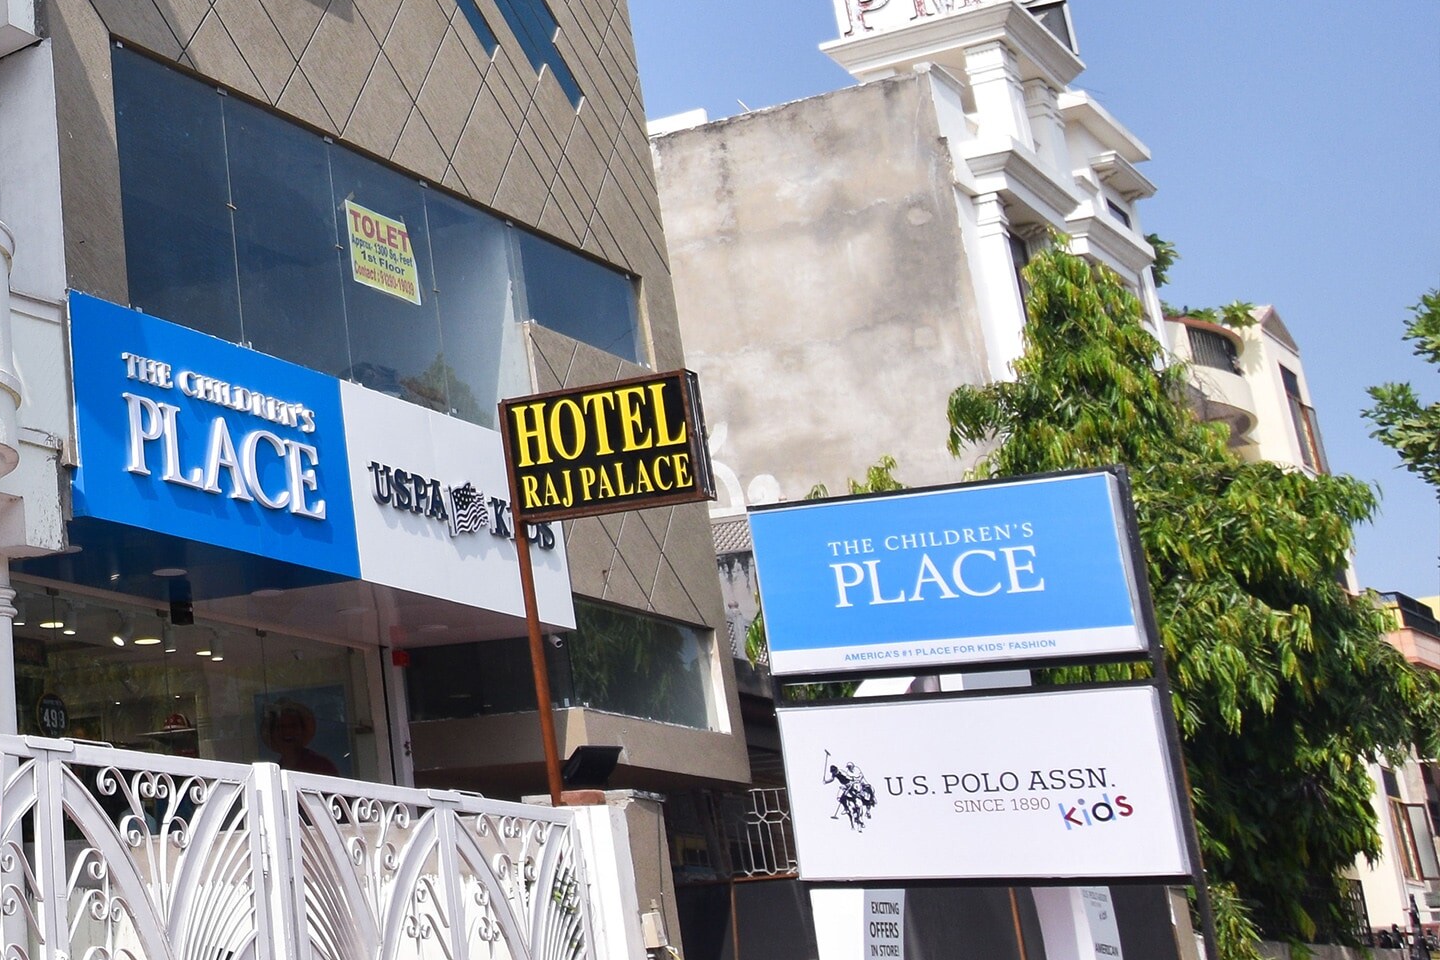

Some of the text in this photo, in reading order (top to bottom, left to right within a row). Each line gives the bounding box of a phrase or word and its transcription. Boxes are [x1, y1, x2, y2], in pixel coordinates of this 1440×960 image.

[350, 209, 409, 253] TOLET
[361, 250, 405, 276] 1st Floor
[400, 252, 413, 268] Feet
[122, 352, 315, 433] THE CHILDREN'S
[512, 383, 687, 468] HOTEL
[122, 392, 326, 520] PLACE
[367, 460, 449, 521] USPA
[522, 453, 693, 509] RAJ PALACE
[828, 522, 1034, 557] THE CHILDREN'S
[829, 545, 1045, 608] PLACE
[844, 650, 900, 662] AMERICA'S
[902, 649, 913, 657] #1
[916, 646, 951, 657] PLACE
[953, 644, 974, 654] FOR
[1009, 640, 1056, 650] FASHION
[884, 768, 1116, 796] U.S. POLO ASSN.
[954, 797, 1051, 813] SINCE 1890
[871, 901, 899, 915] EXCITING
[870, 921, 899, 938] OFFERS
[871, 944, 878, 957] IN
